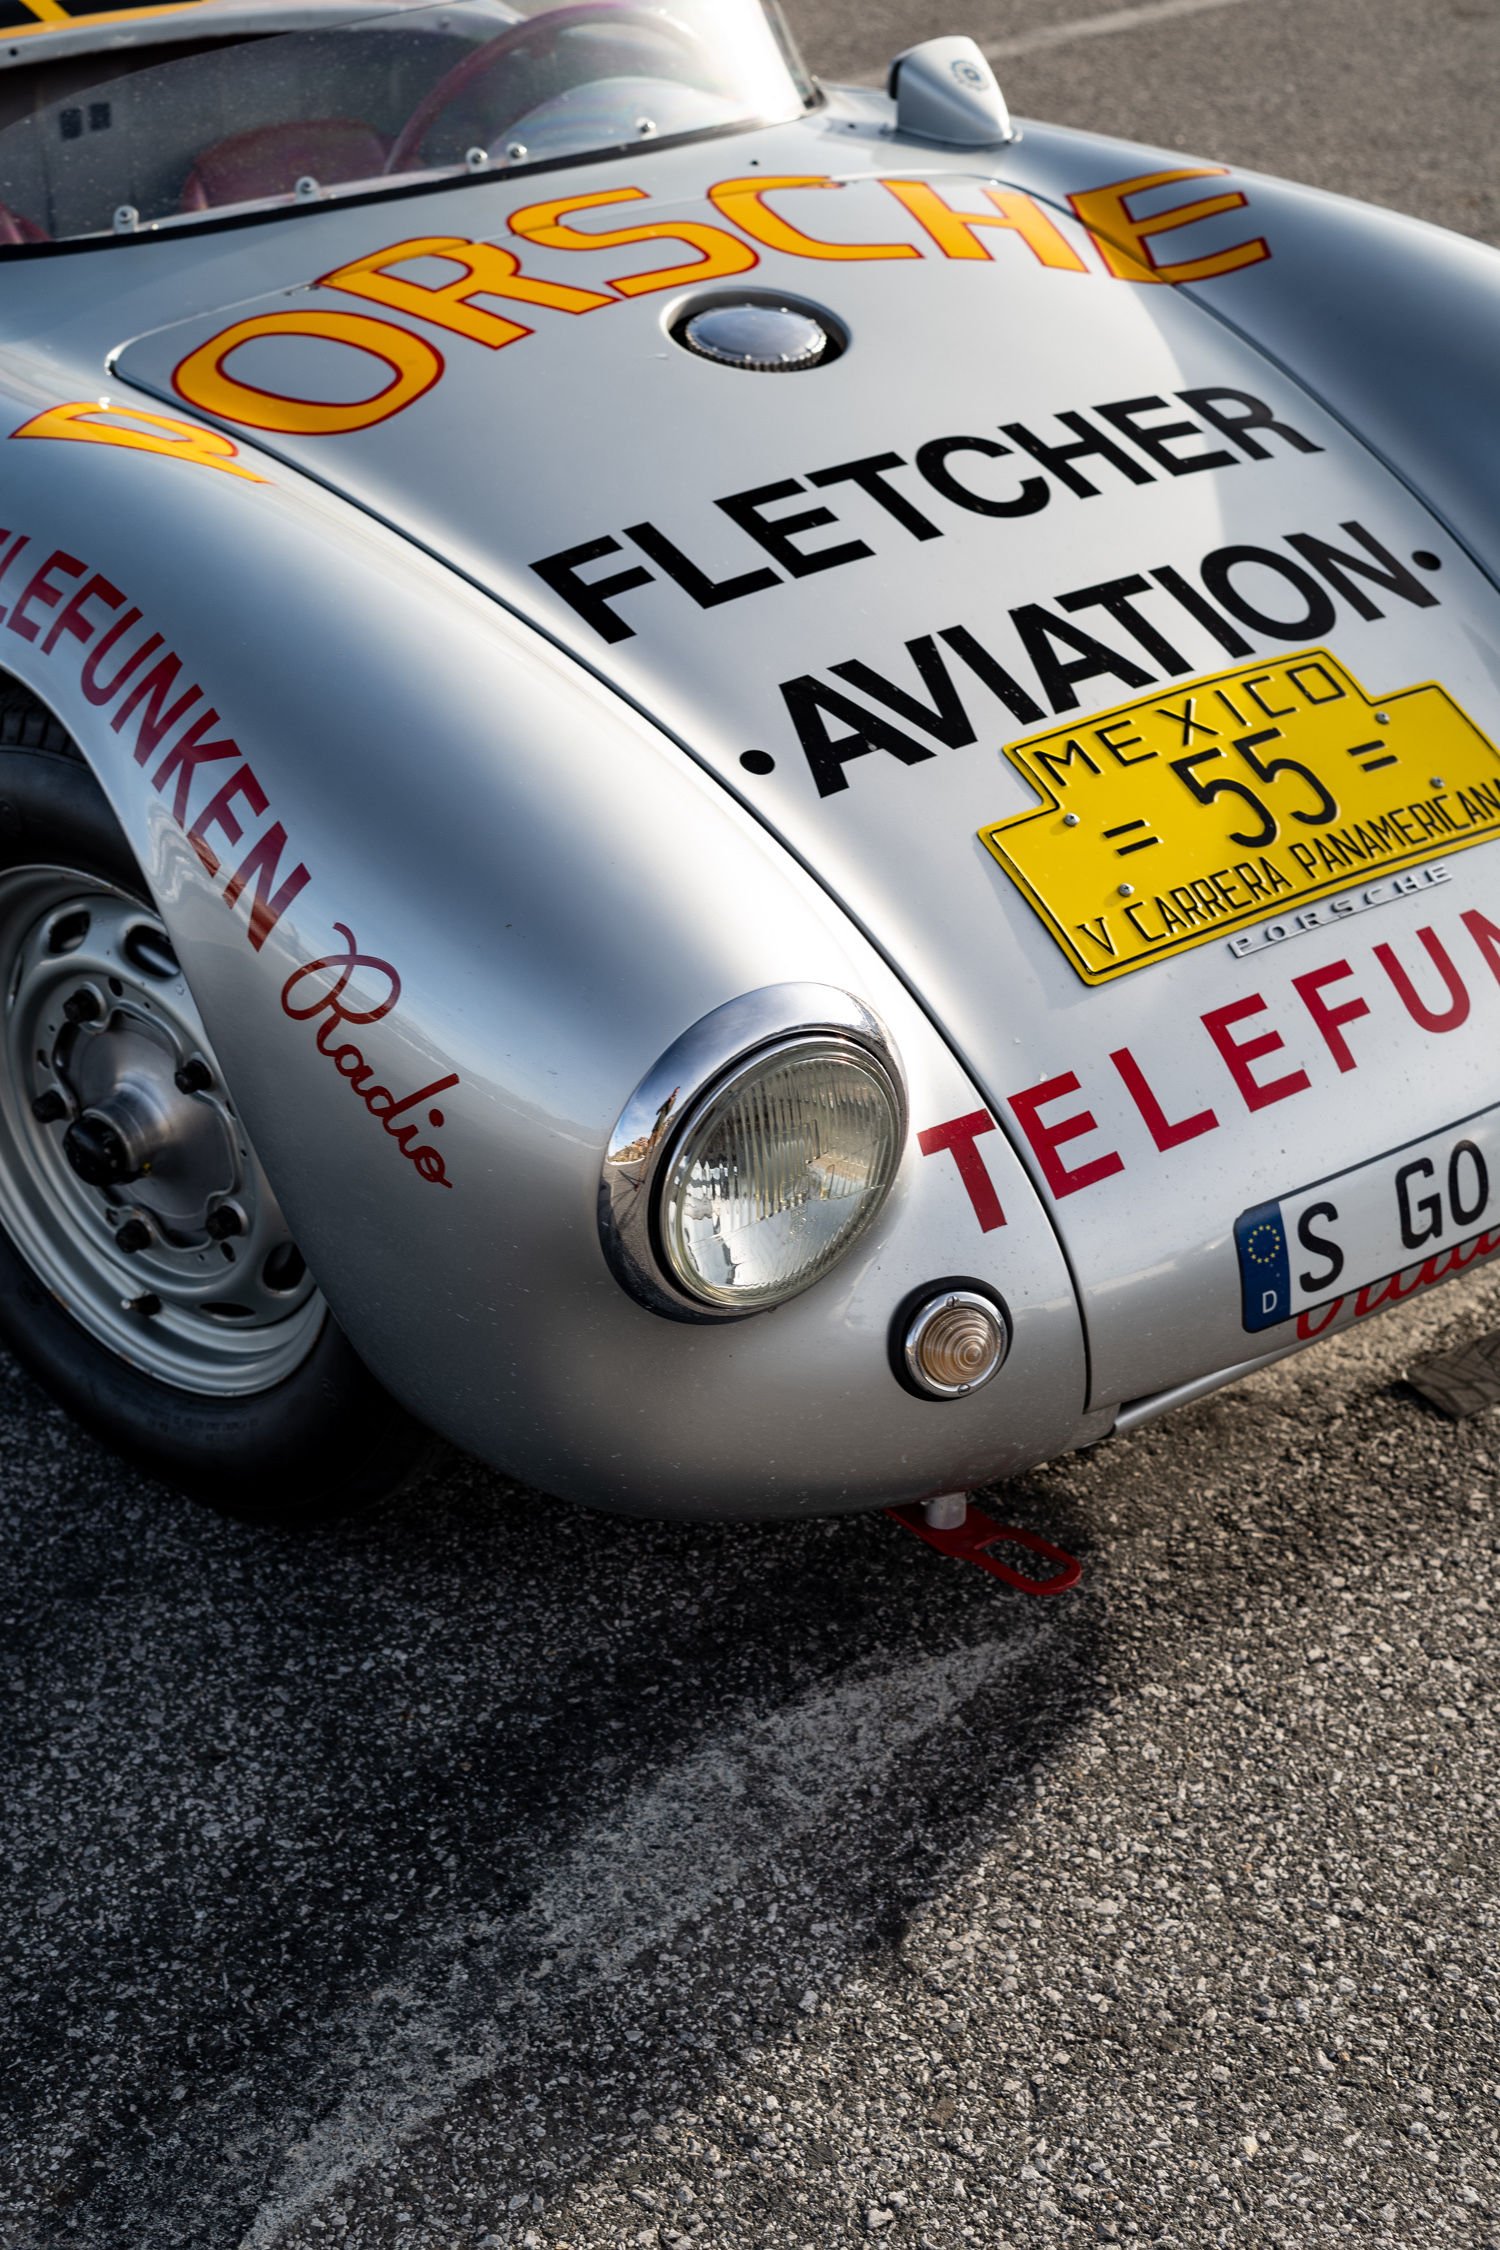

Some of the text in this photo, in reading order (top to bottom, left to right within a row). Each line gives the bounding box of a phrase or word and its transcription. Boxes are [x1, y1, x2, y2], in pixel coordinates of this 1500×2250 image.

[8, 167, 1272, 483] PORSCHE
[528, 386, 1327, 644] FLETCHER
[1032, 663, 1350, 787] MEXICO
[1169, 727, 1341, 848] 55
[1077, 778, 1500, 956] V CARRERA PANAMERICAN
[1228, 863, 1454, 959] PORSCHE
[280, 922, 460, 1189] Radio
[1261, 1289, 1278, 1314] D
[1298, 1201, 1345, 1293] S
